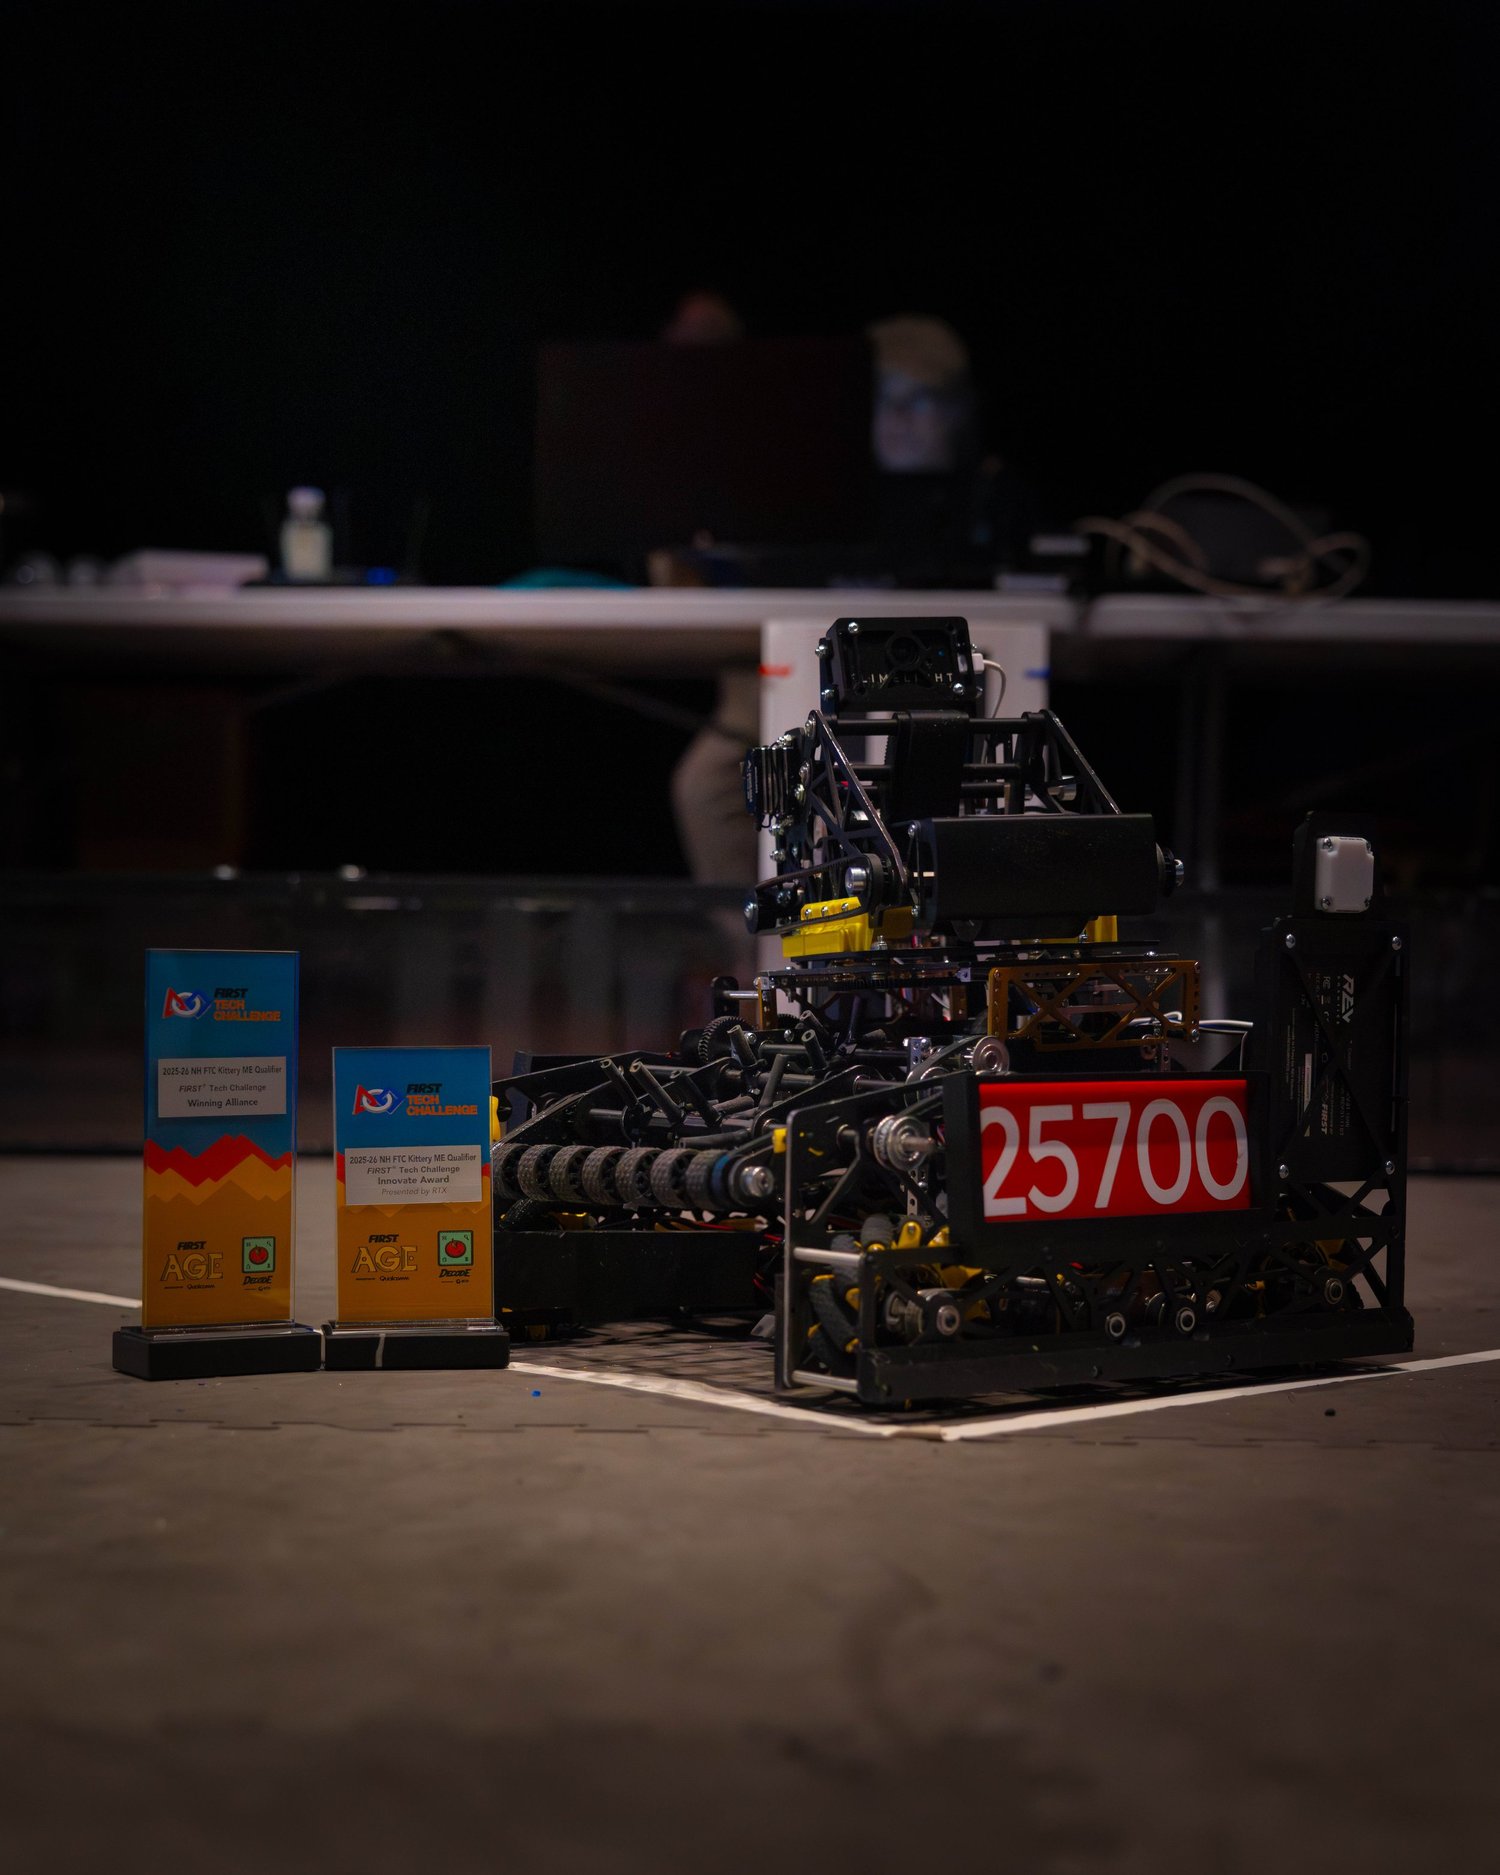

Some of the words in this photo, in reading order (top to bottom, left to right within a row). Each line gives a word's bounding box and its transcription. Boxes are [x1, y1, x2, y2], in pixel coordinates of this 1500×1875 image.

[863, 673, 953, 684] IMELIHT
[214, 988, 248, 998] FIRST
[1341, 974, 1355, 1024] REV
[214, 1000, 245, 1009] TECH
[213, 1010, 281, 1021] CHALLENGE
[163, 1067, 190, 1075] 2025-26
[191, 1067, 202, 1075] NH
[204, 1066, 216, 1075] FTC
[218, 1066, 240, 1076] Kittery
[243, 1065, 253, 1074] ME
[255, 1065, 282, 1074] Qualifier
[210, 1084, 228, 1092] Tech
[230, 1083, 266, 1092] Challenge
[406, 1083, 442, 1093] FIRST
[188, 1099, 222, 1108] Winning
[225, 1098, 258, 1106] Alliance
[406, 1095, 440, 1104] TECH
[406, 1105, 478, 1116] CHALLENGE
[1320, 1103, 1328, 1135] FIRST
[350, 1156, 378, 1164] 2025-26
[393, 1155, 406, 1163] FTC
[408, 1155, 432, 1164] Kittery
[434, 1154, 445, 1162] ME
[447, 1153, 476, 1161] Qualifier
[979, 1095, 1248, 1217] 25700
[421, 1165, 460, 1174] Challenge
[377, 1177, 418, 1185] Innovate
[420, 1175, 450, 1183] Award
[421, 1188, 430, 1196] by
[368, 1234, 399, 1243] FIRST
[177, 1241, 207, 1250] FIRST
[352, 1245, 417, 1273] AGE
[160, 1252, 224, 1281] AGE
